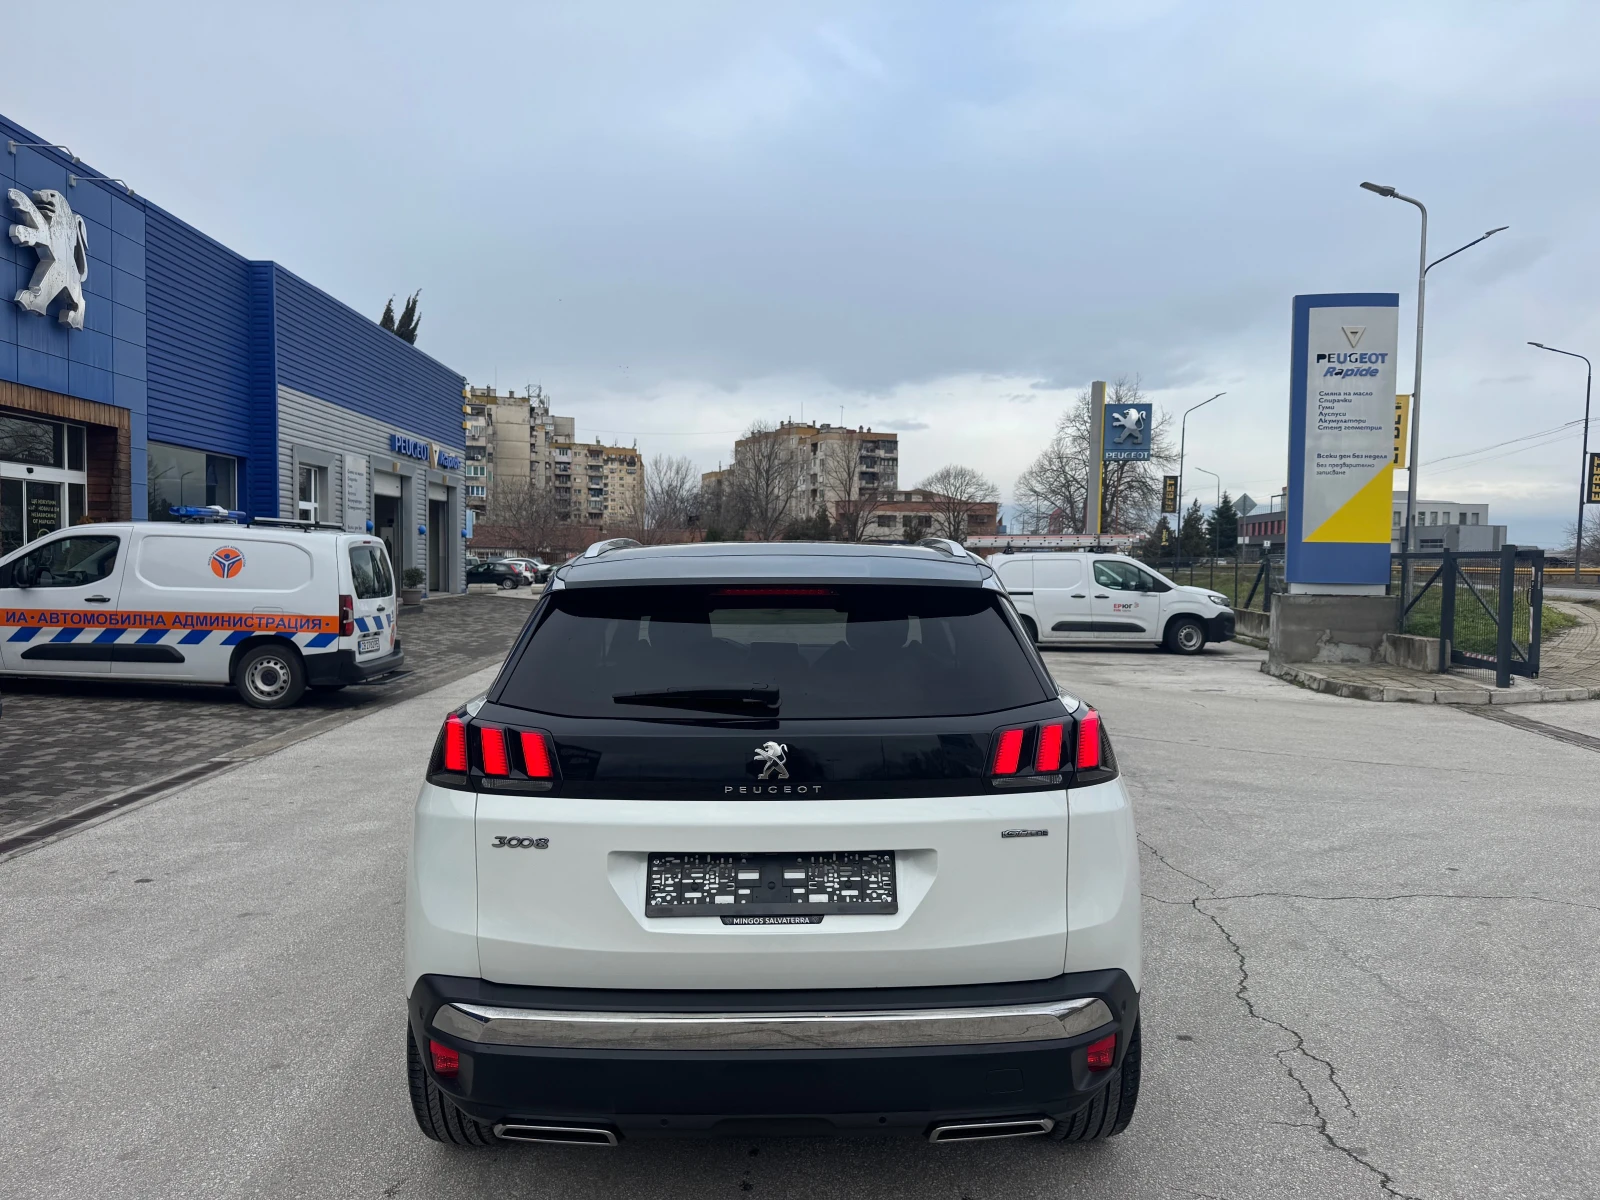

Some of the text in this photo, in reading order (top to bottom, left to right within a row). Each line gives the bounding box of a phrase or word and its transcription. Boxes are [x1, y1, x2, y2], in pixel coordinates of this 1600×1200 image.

[1316, 352, 1389, 364] PEUGEOT
[1323, 366, 1380, 379] Rapide
[393, 434, 430, 461] PEUGEOT
[1105, 451, 1149, 459] PEUGEOT
[5, 611, 322, 631] ИА АВТОМОБИЛНА АДМИНИСТРАЦИЯ
[724, 785, 822, 794] PEUGEOT
[491, 835, 550, 849] 3008
